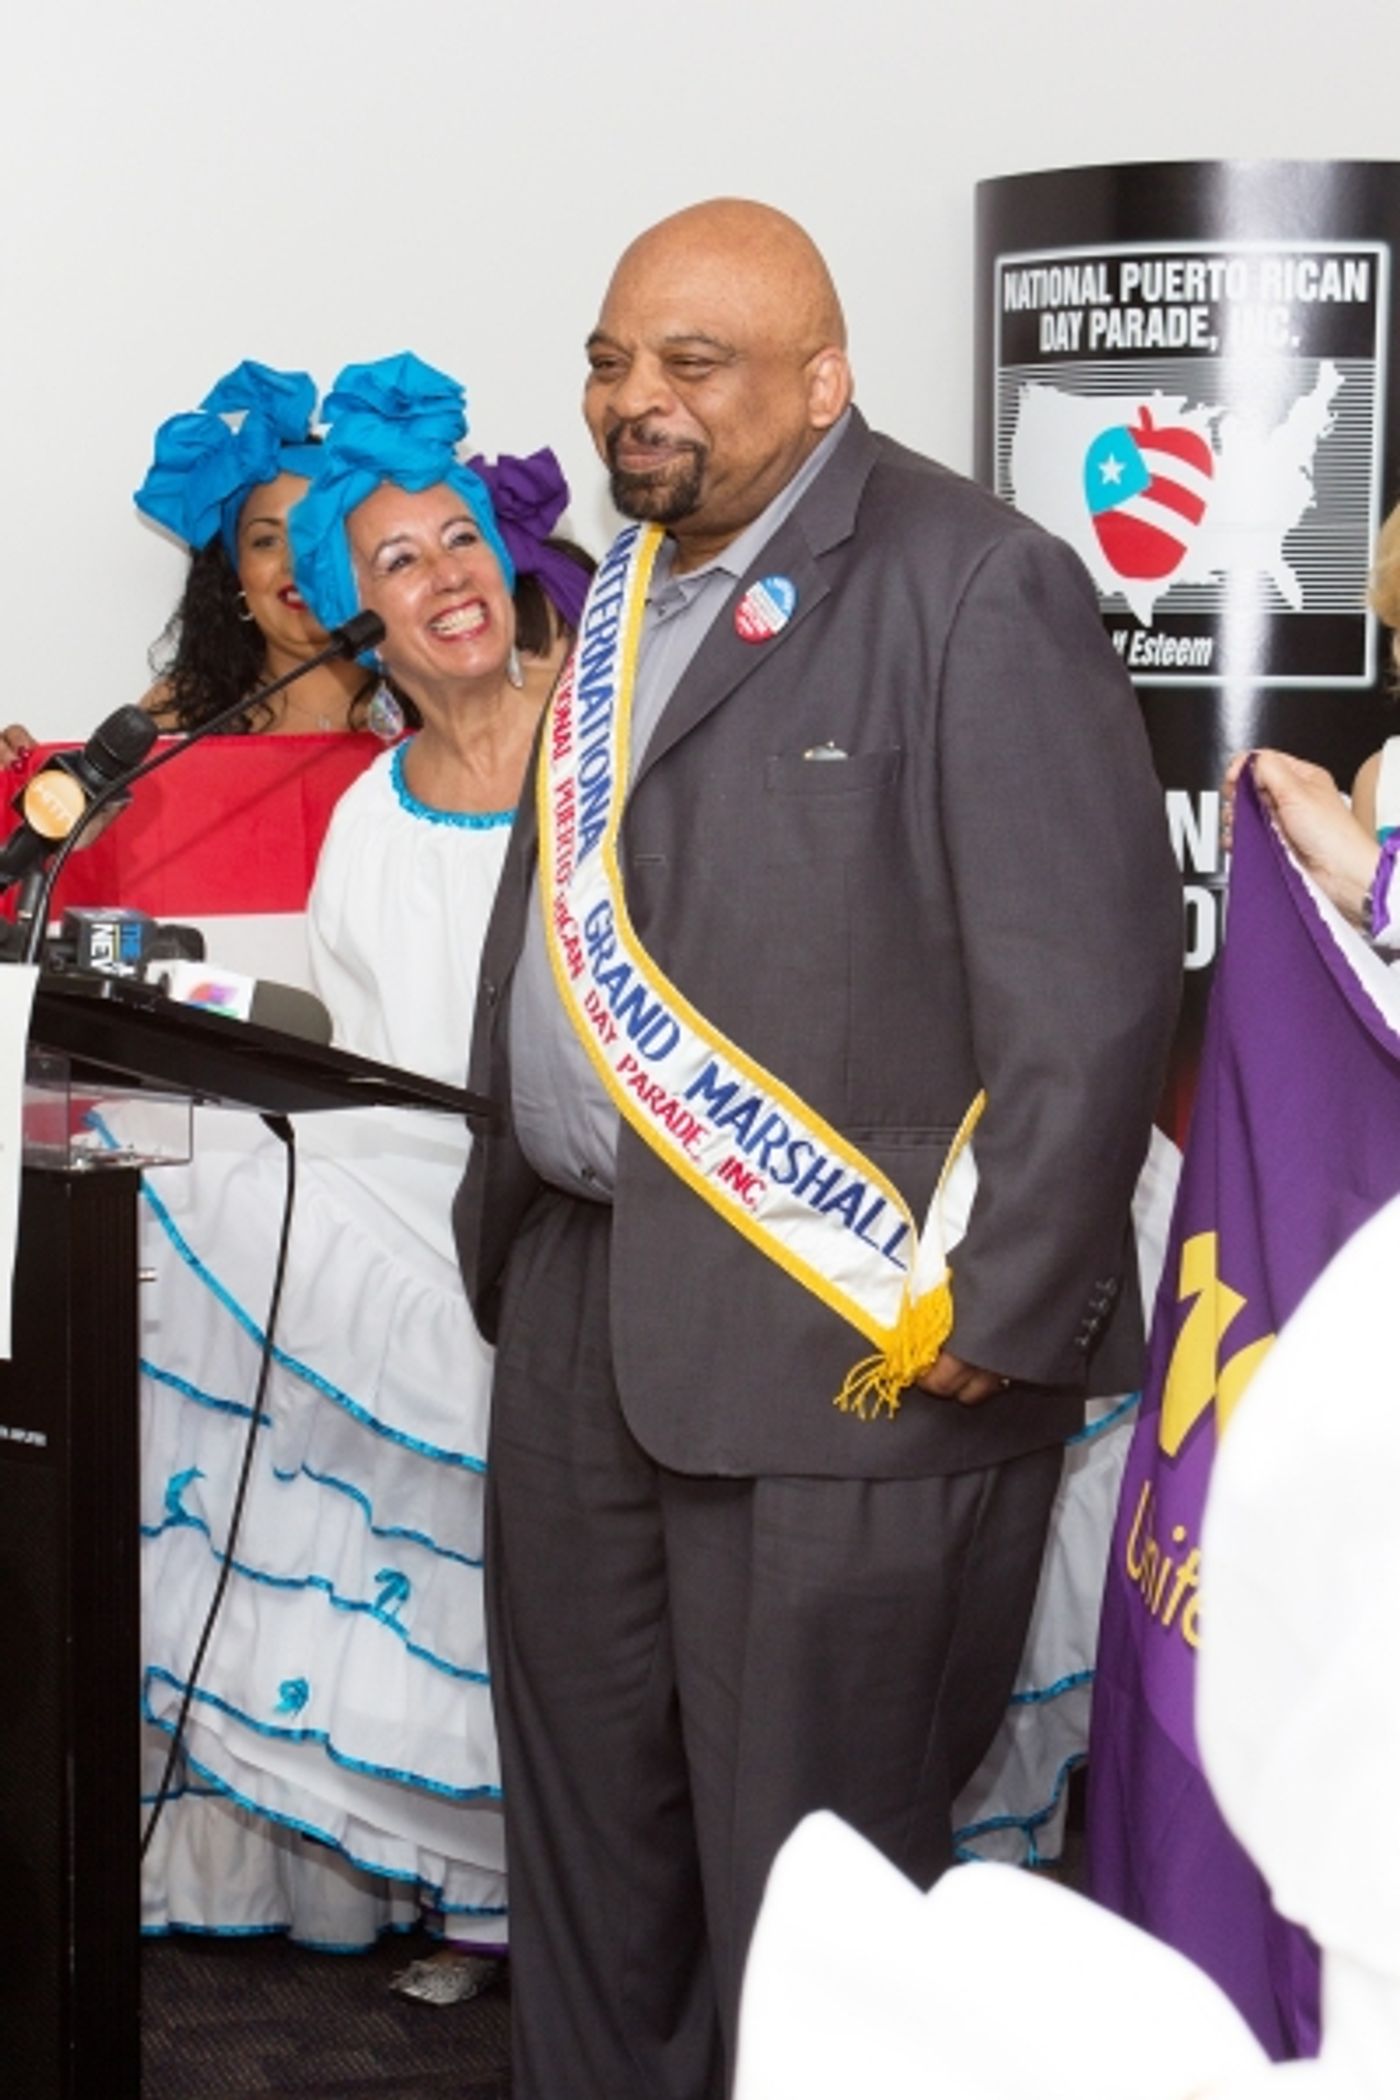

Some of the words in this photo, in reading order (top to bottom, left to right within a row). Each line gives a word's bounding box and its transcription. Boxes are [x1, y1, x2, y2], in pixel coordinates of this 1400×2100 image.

[1004, 262, 1112, 312] NATIONAL
[1120, 258, 1248, 303] PUERTO
[1259, 258, 1370, 303] RICAN
[1039, 312, 1083, 353] DAY
[1088, 306, 1218, 352] PARADE,
[1127, 629, 1213, 666] Esteem
[575, 524, 643, 868] INTERNATIONA
[584, 899, 682, 1062] GRAND
[584, 989, 619, 1046] DAY
[684, 1060, 911, 1272] MARSHALL
